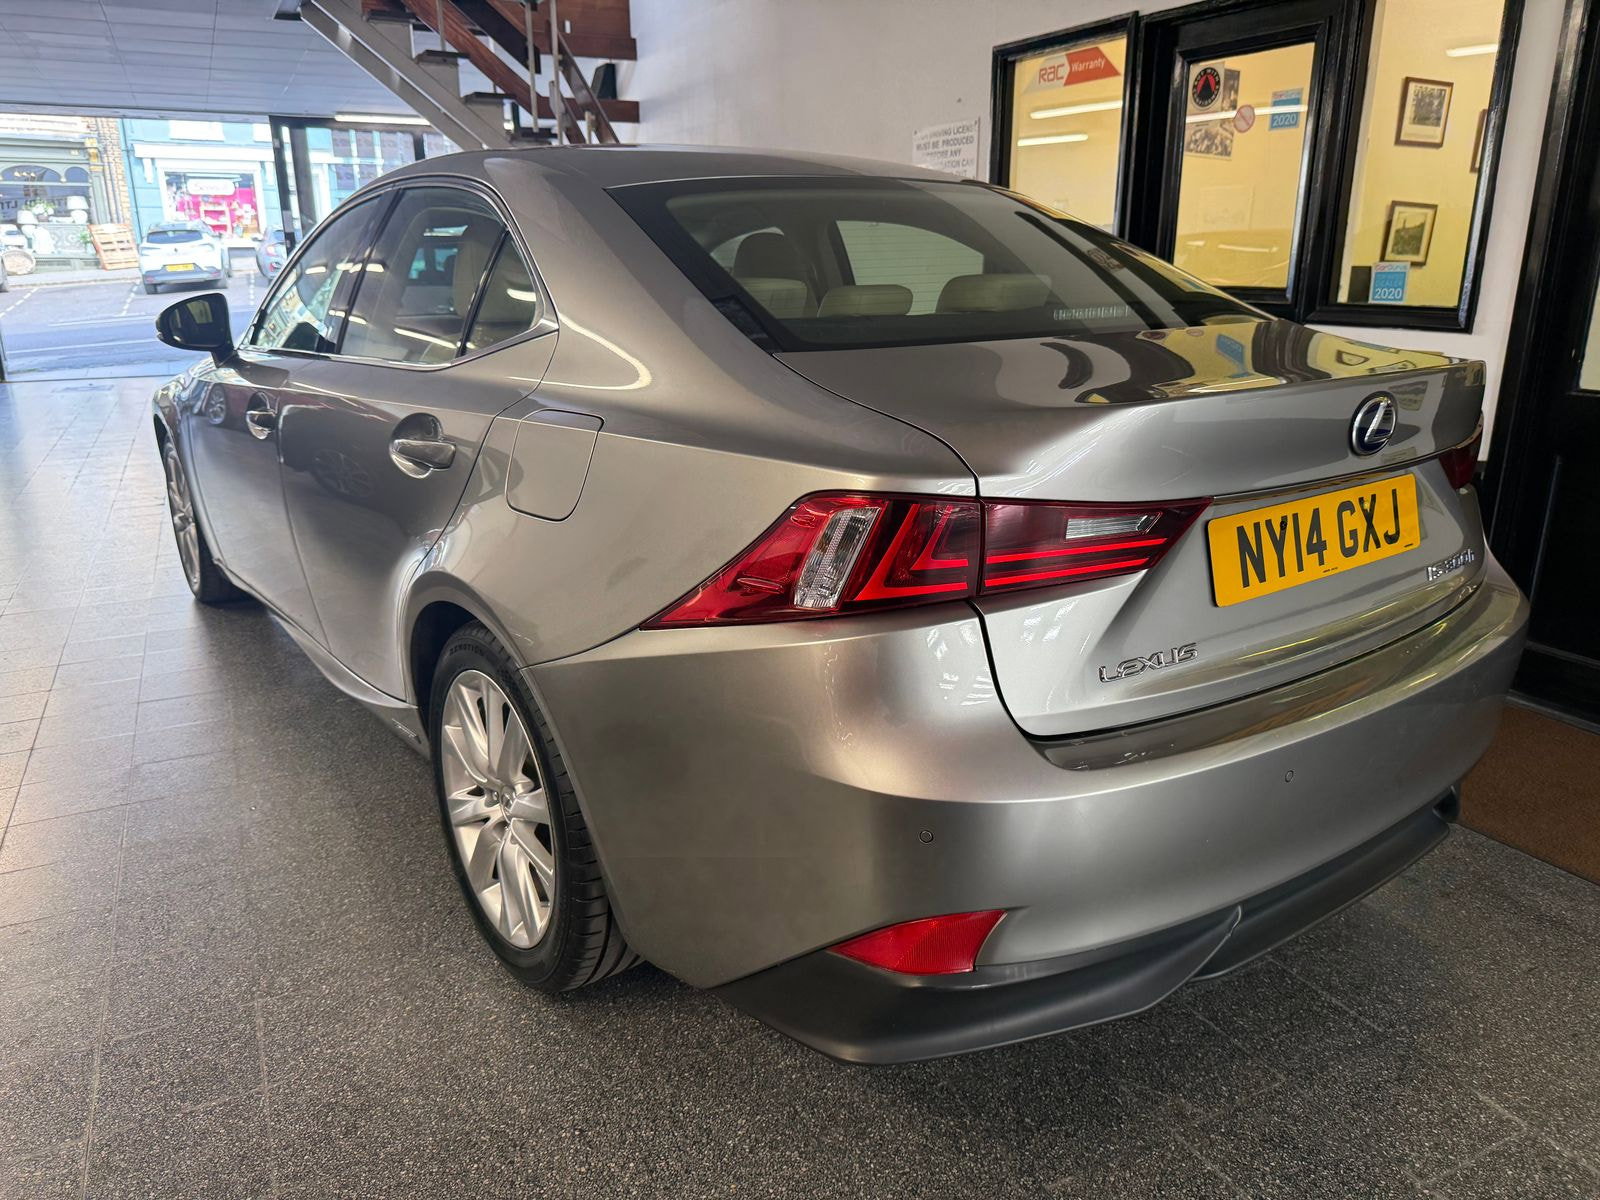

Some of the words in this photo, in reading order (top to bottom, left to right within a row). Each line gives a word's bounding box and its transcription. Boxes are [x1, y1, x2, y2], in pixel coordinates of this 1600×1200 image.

[1071, 56, 1106, 72] Warranty
[1273, 113, 1297, 126] 2020
[916, 142, 930, 152] MUST
[932, 140, 941, 150] BE
[943, 136, 975, 147] PRODUCED
[949, 148, 961, 158] ANY
[1374, 288, 1402, 299] 2020
[1236, 507, 1328, 588] NY14
[1336, 488, 1400, 559] GXJ
[1099, 642, 1198, 683] LEXUS
